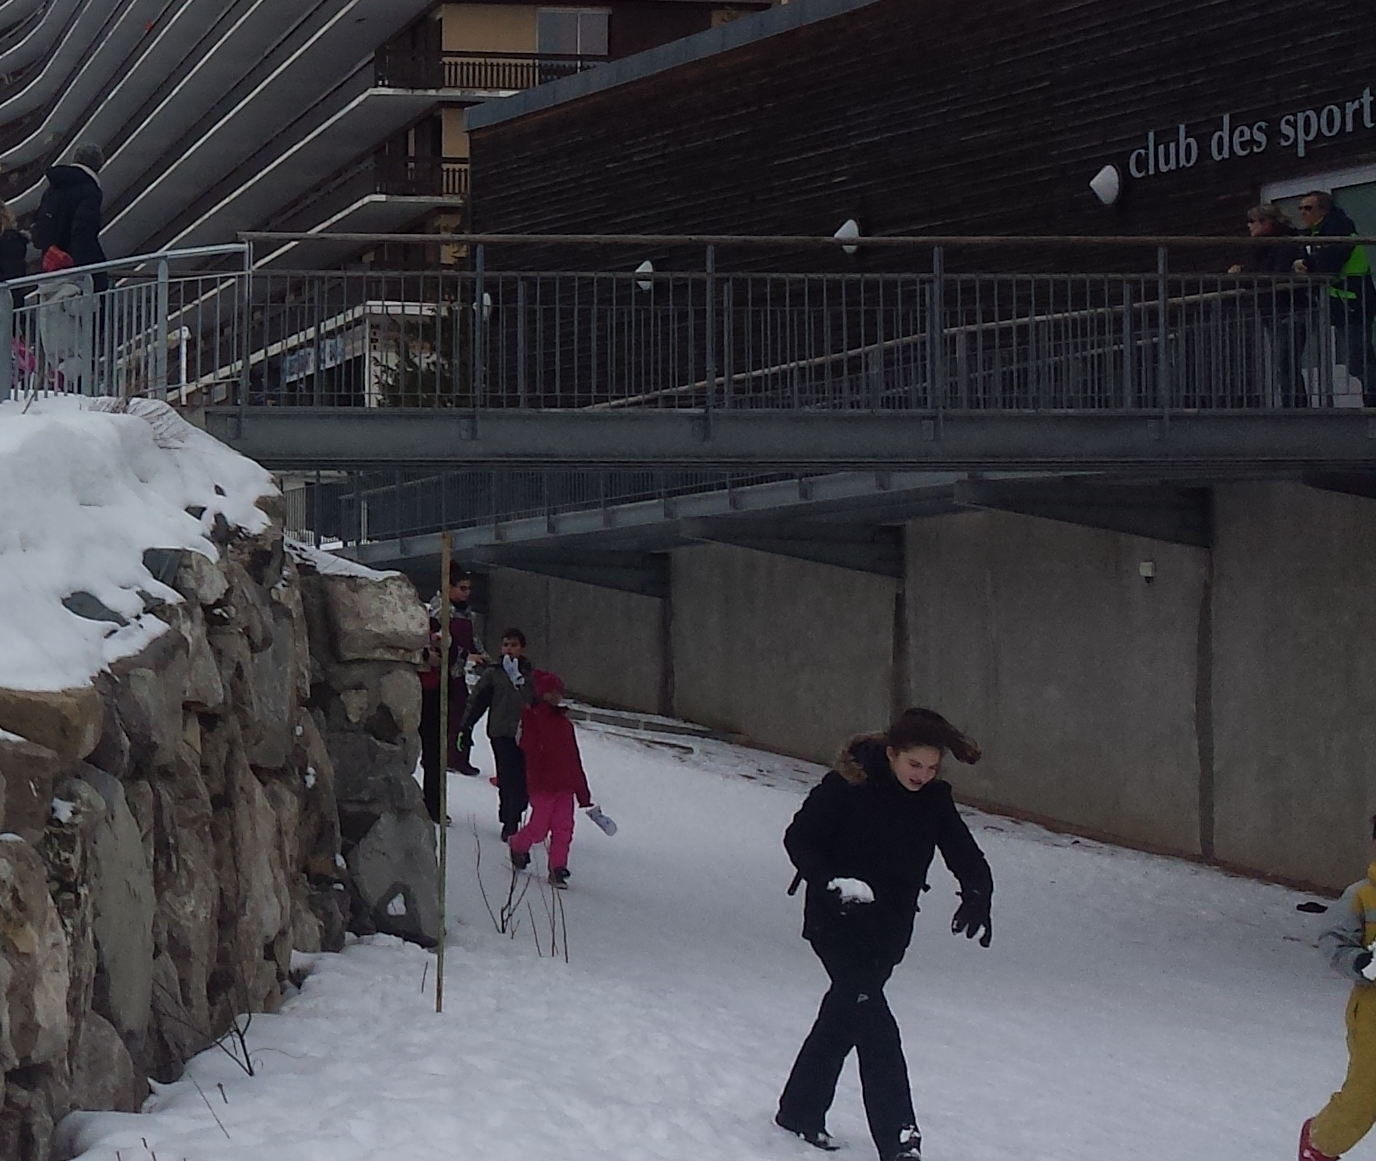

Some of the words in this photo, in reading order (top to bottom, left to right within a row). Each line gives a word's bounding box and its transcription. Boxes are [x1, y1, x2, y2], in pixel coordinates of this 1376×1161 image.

[1129, 124, 1198, 178] club
[1210, 113, 1269, 161] des
[1279, 86, 1376, 157] sport
